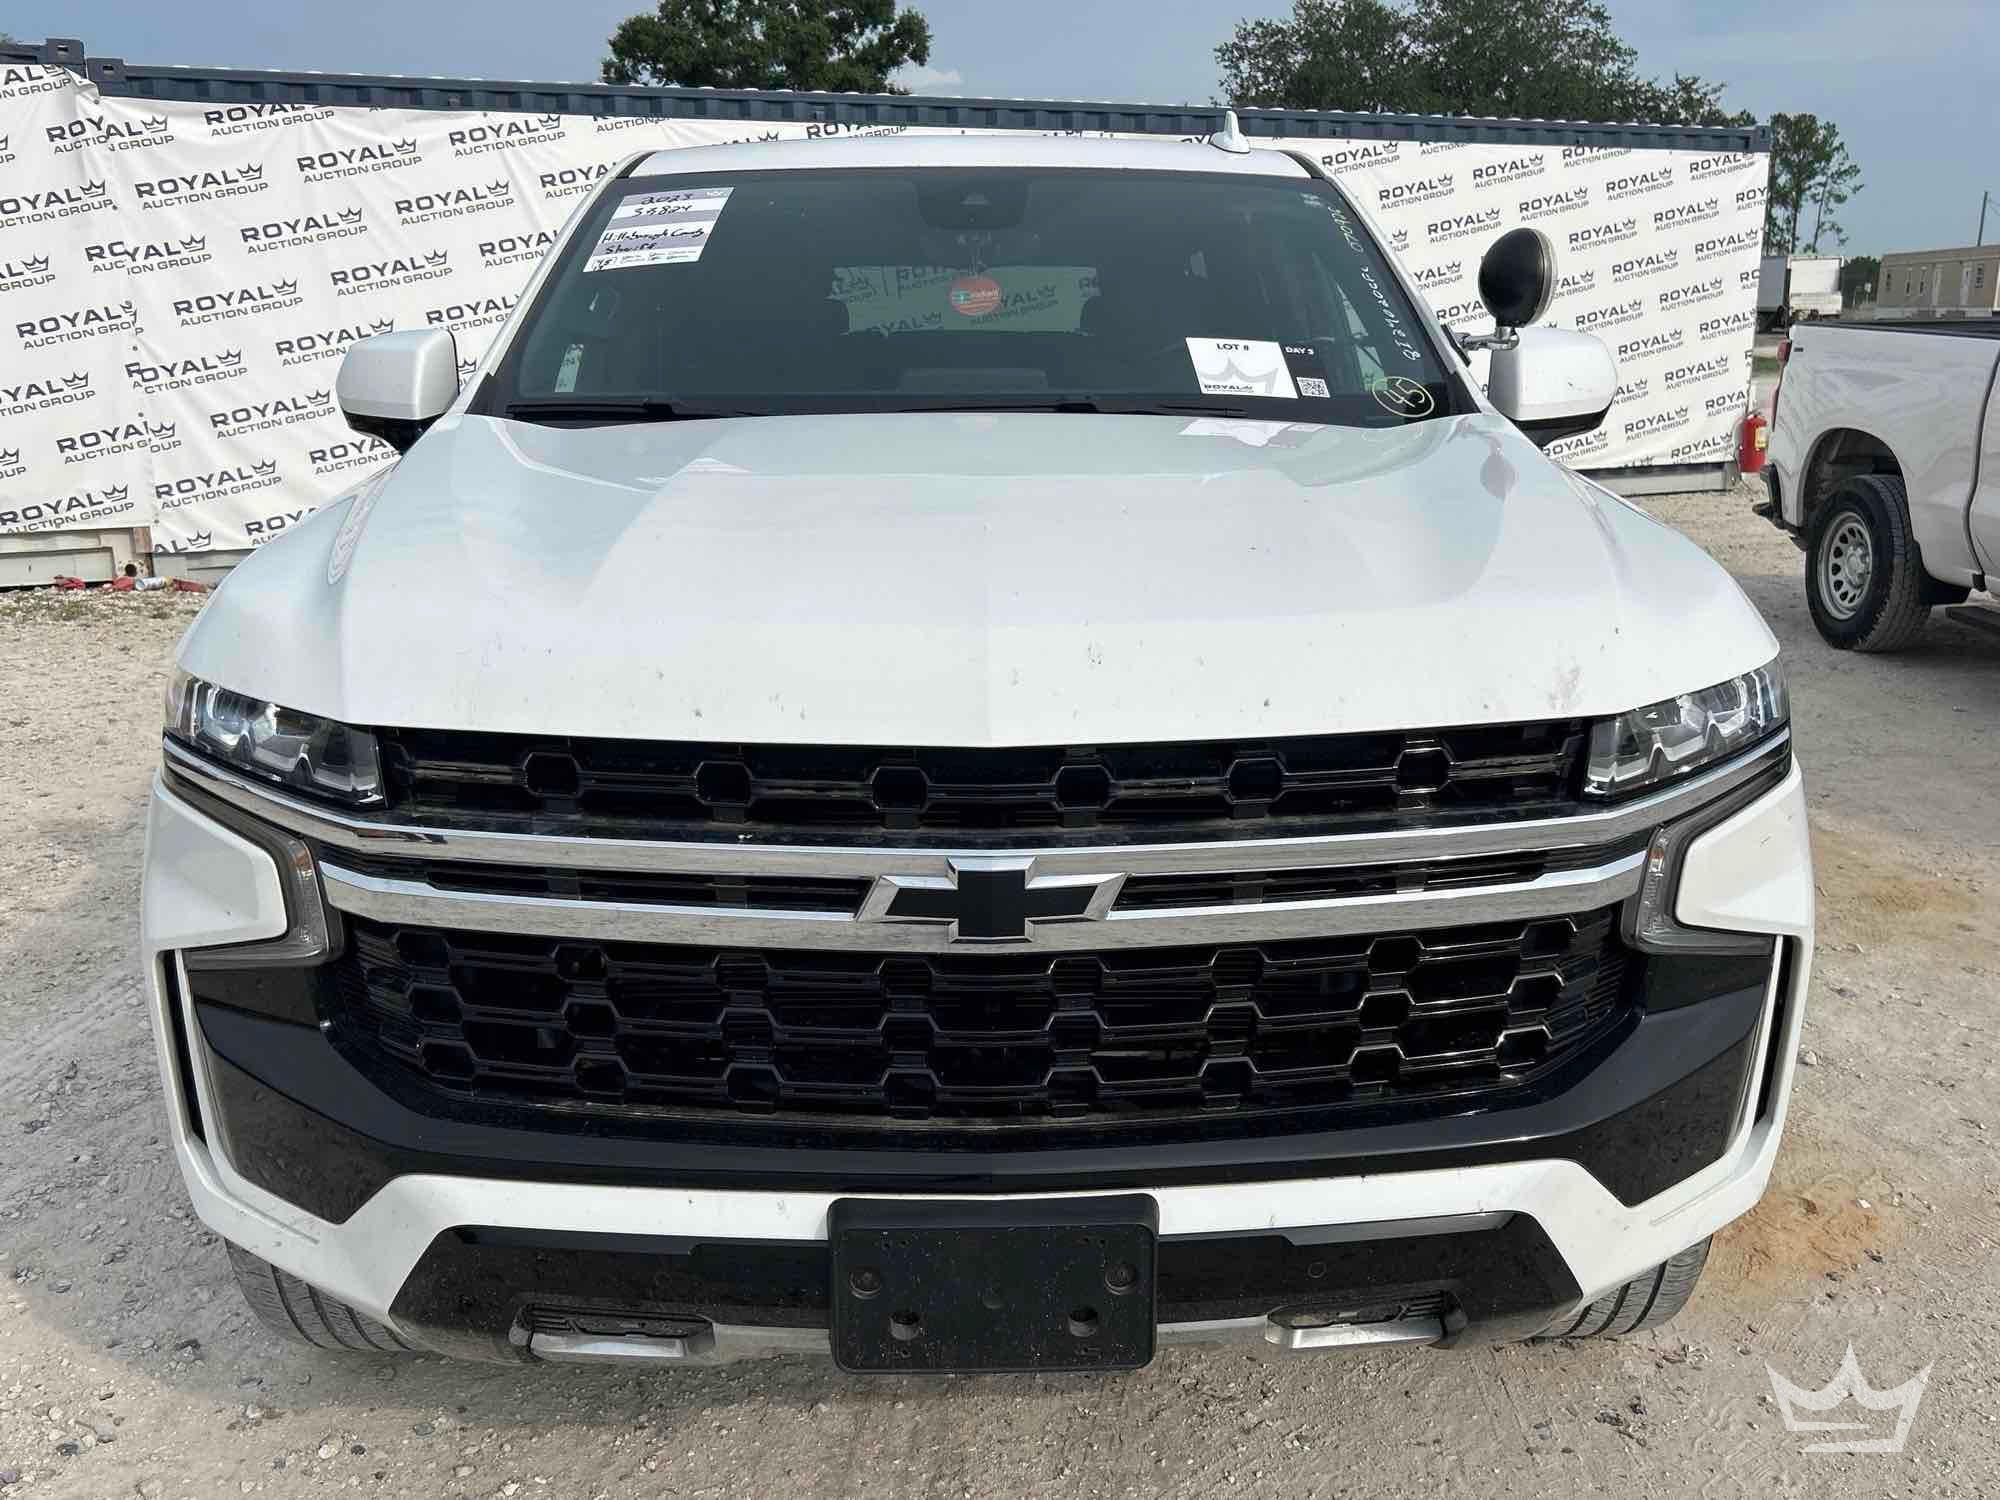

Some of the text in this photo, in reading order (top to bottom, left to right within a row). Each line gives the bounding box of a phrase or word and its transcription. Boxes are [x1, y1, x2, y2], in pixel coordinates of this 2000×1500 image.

[19, 78, 71, 96] GROUP
[211, 110, 334, 137] AUCTION GROUP
[449, 119, 532, 146] ROYAL
[119, 135, 174, 150] GROUP
[454, 131, 566, 158] AUCTION GROUP
[297, 144, 394, 172] ROYAL
[1322, 146, 1383, 167] ROYAL
[1689, 154, 1742, 174] ROYAL
[303, 156, 422, 184] AUCTION GROUP
[539, 164, 609, 189] ROYA
[1472, 158, 1530, 180] ROYAL
[134, 170, 239, 199] ROYAL
[545, 183, 594, 200] AUCTIO
[1379, 178, 1438, 201] ROYAL
[1605, 174, 1659, 193] ROYAL
[0, 188, 82, 215] OYAL
[142, 182, 269, 210] AUCTION GROUP
[395, 187, 487, 215] ROYAL
[1519, 192, 1574, 213] ROYAL
[1735, 187, 1767, 204] ROY
[1736, 199, 1766, 211] AUCTIO
[0, 199, 114, 229] CTION GROUP
[400, 198, 514, 226] AUCTION GROUP
[1653, 204, 1705, 224] ROYAL
[240, 214, 338, 243] ROYAL
[1427, 213, 1486, 236] ROYAL
[1568, 224, 1623, 244] ROYAL
[247, 225, 368, 255] AUCTION GROUP
[478, 232, 555, 257] ROYA
[1694, 235, 1746, 255] ROYAL
[92, 253, 212, 275] AUCION GROUP
[485, 250, 545, 268] AUCTION
[1612, 254, 1665, 275] ROYAL
[330, 256, 425, 286] ROYAL
[337, 268, 452, 296] AUCTION GROUP
[1414, 266, 1447, 282] YAL
[0, 274, 56, 292] GROUP
[1659, 284, 1709, 304] ROYAL
[173, 286, 274, 316] ROYAL
[180, 297, 304, 328] AUCTION GROUP
[425, 298, 514, 325] ROYAL
[1436, 300, 1482, 321] ROYA
[16, 306, 121, 339] ROYAL
[1575, 306, 1629, 326] ROYAL
[1699, 313, 1750, 333] ROYAL
[23, 328, 94, 350] AUCTION
[275, 325, 372, 356] ROYAL
[1216, 343, 1240, 351] LOT
[1285, 346, 1305, 355] DAY
[1618, 335, 1670, 356] ROYAL
[281, 346, 347, 368] AUCTION
[132, 367, 248, 395] ACTION GROUP
[1664, 362, 1716, 383] ROYAL
[0, 379, 65, 402] YAL
[1705, 392, 1745, 411] ROYA
[0, 390, 97, 417] TION GROUP
[210, 396, 308, 429] ROYAL
[216, 406, 336, 440] AUCTION GROUP
[1624, 414, 1675, 434] ROYAL
[64, 438, 182, 465] AUCTION GOUP
[308, 436, 387, 465] ROYA
[1671, 440, 1721, 459] ROYAL
[315, 454, 378, 475] AUCTION
[154, 465, 254, 500] ROYAL
[161, 476, 282, 510] AUCTION GROUP
[0, 493, 104, 525] ROYAL
[80, 503, 134, 521] GROUP
[245, 508, 312, 536] ROY
